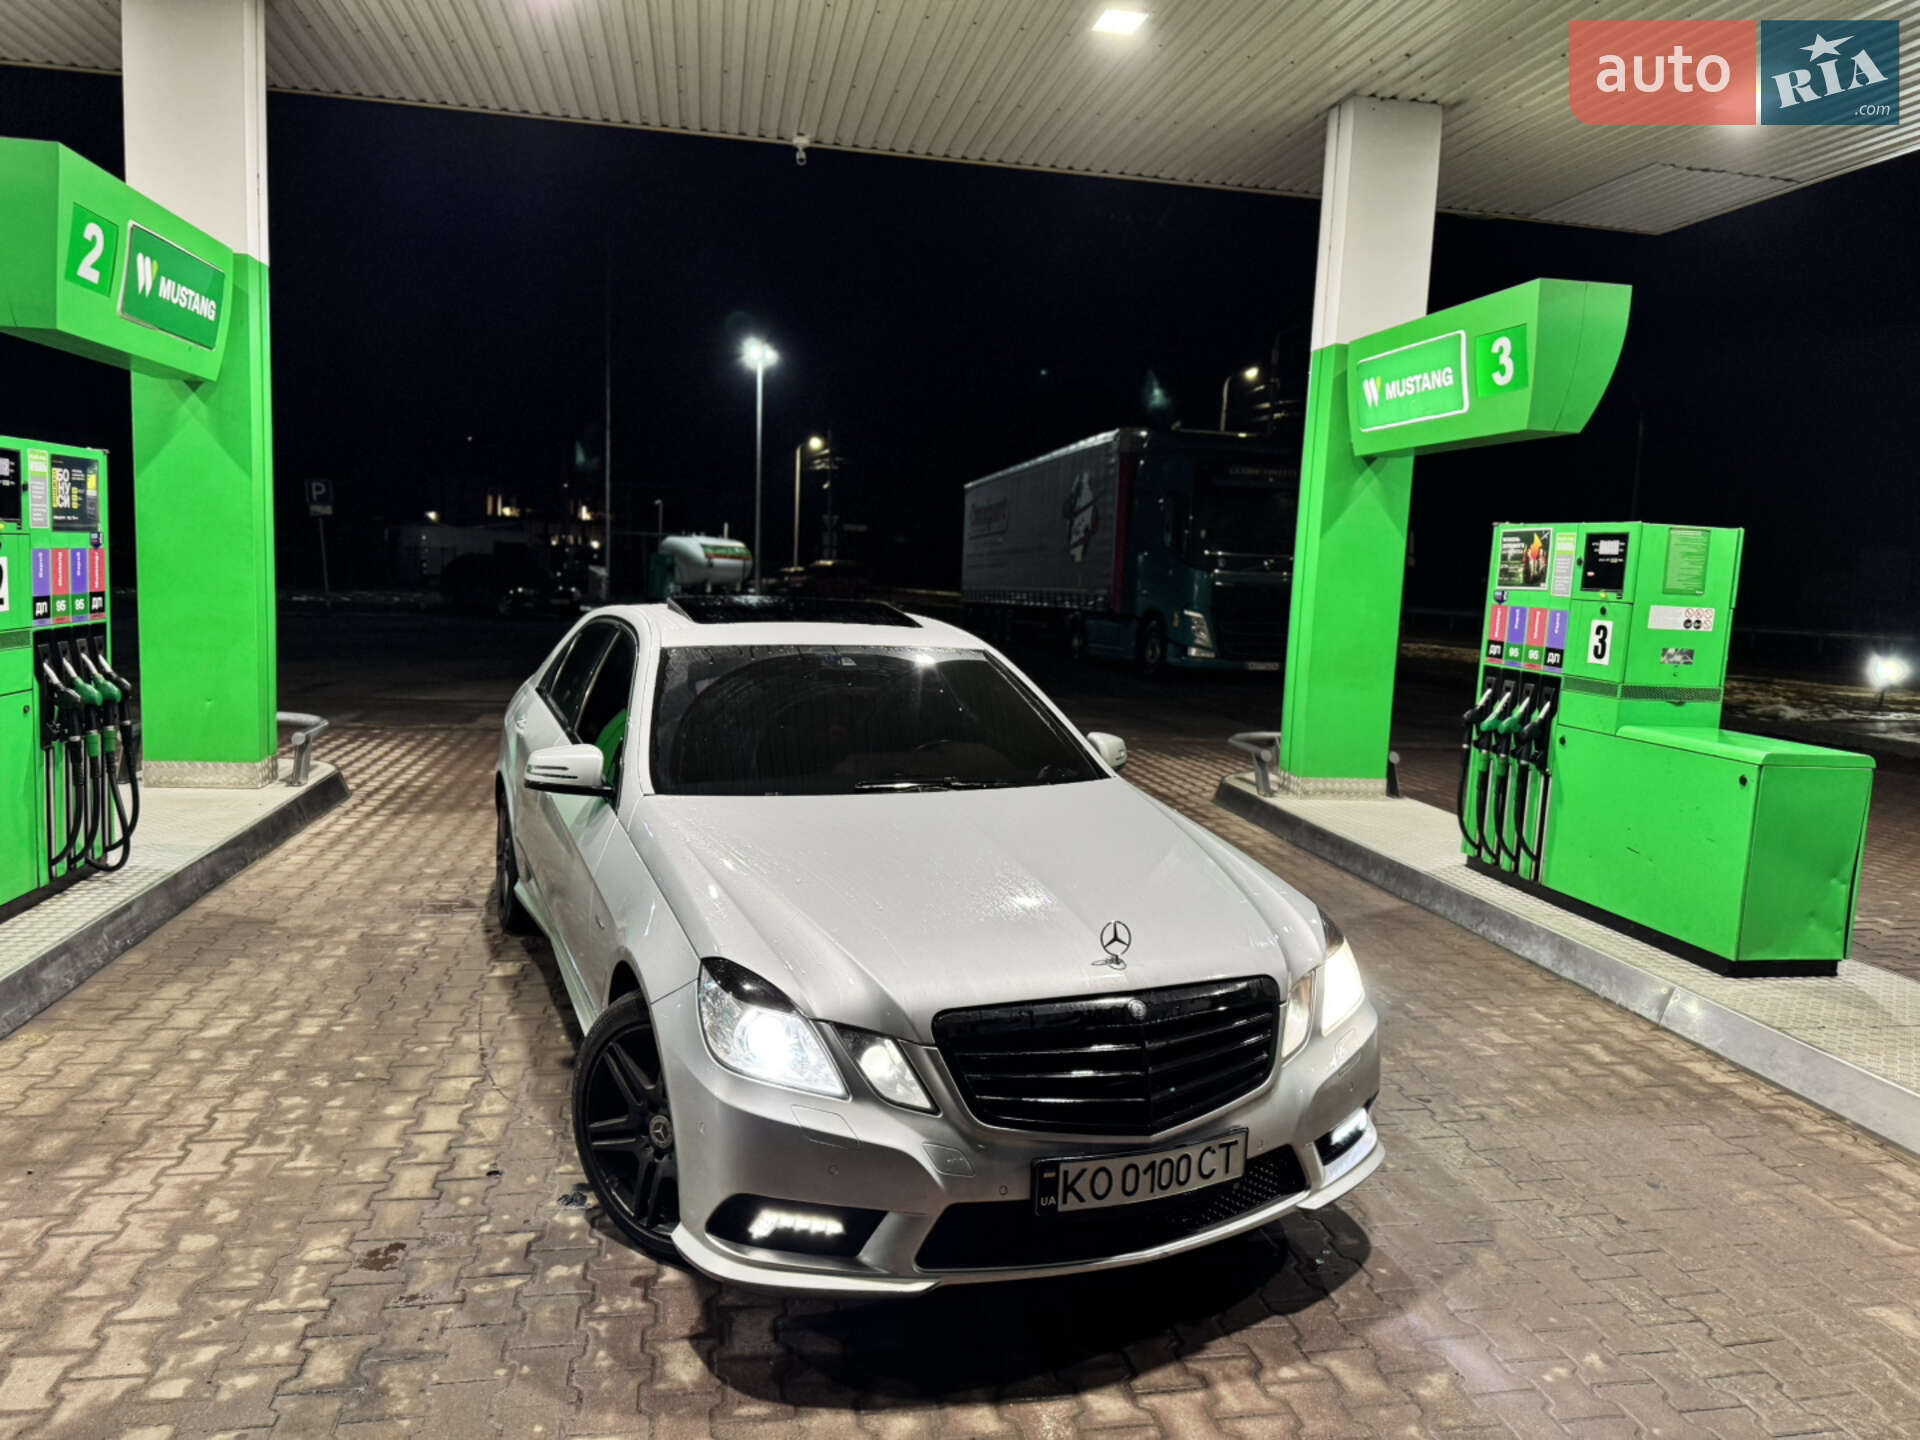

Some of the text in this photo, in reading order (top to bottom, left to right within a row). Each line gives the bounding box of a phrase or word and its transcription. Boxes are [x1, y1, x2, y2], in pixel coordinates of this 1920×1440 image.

[76, 222, 105, 285] 2
[158, 275, 217, 322] MUSTANG
[1490, 336, 1515, 386] 3
[1385, 367, 1455, 401] MUSTANG
[311, 481, 326, 501] P
[1592, 624, 1608, 660] 3
[1061, 1139, 1239, 1205] KO 0100 CT
[1040, 1196, 1057, 1207] UA
